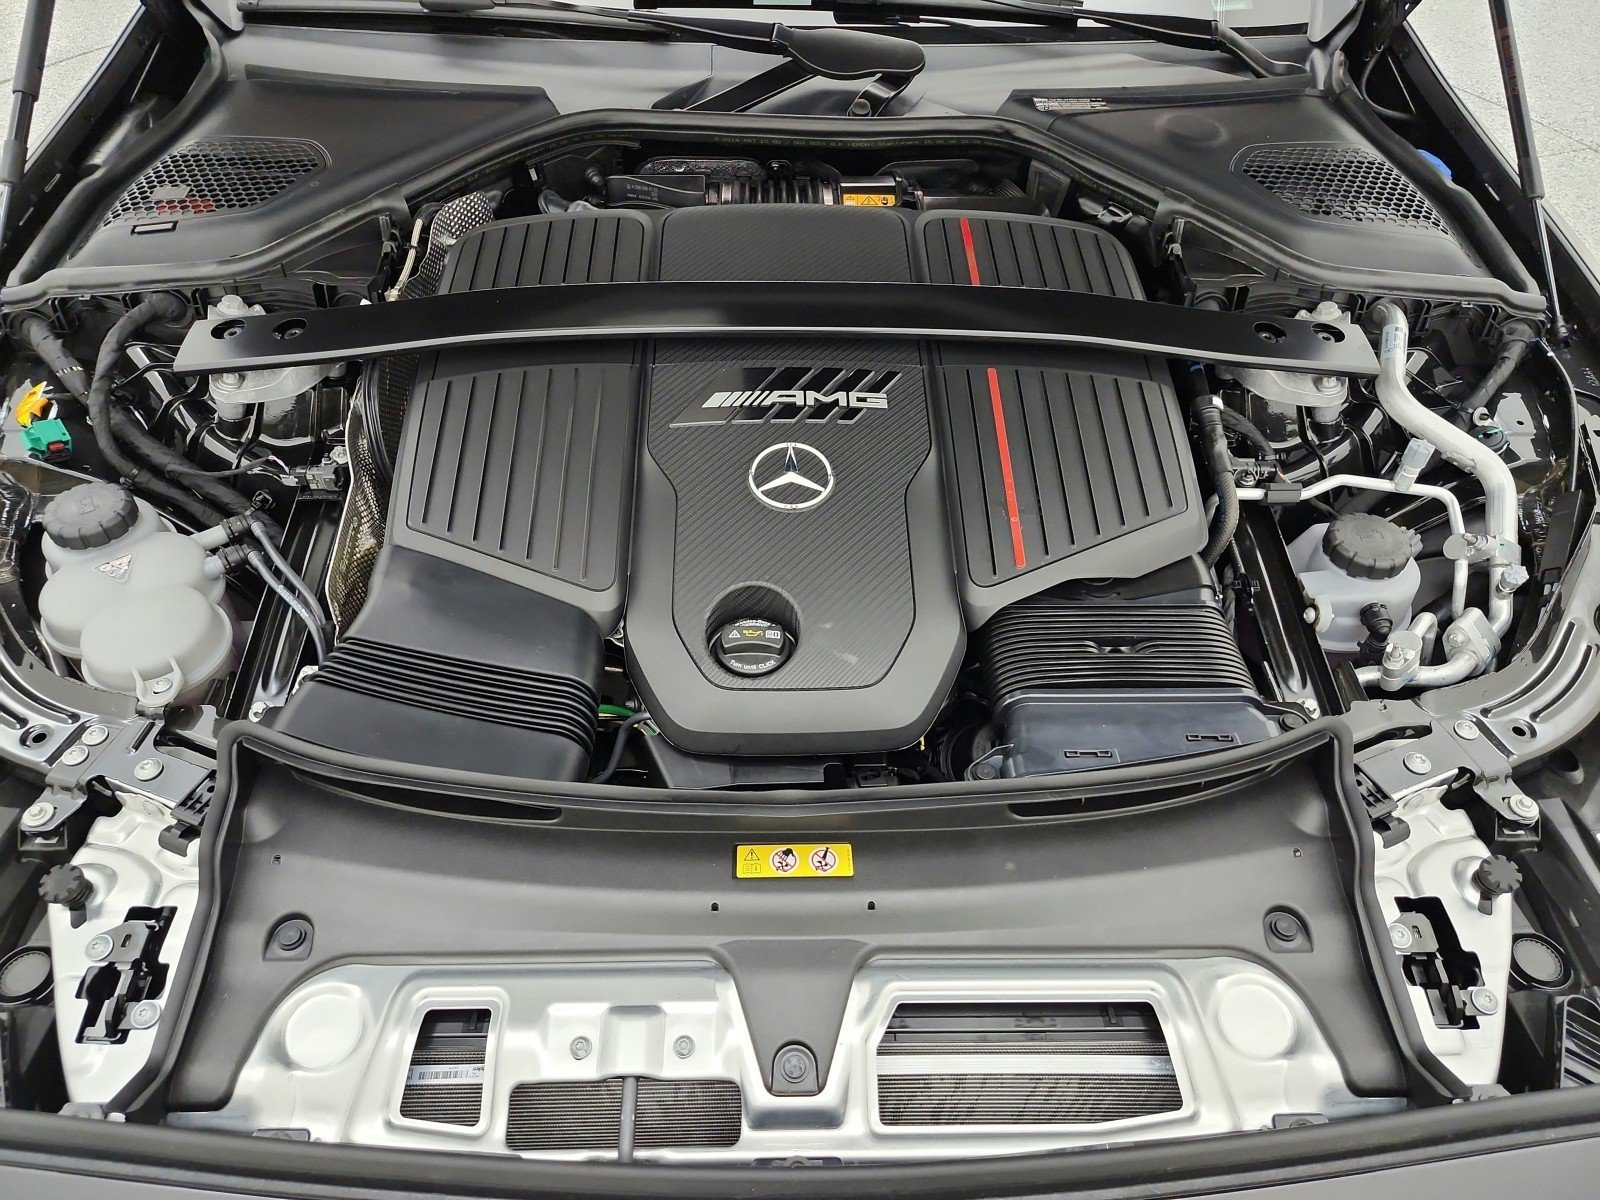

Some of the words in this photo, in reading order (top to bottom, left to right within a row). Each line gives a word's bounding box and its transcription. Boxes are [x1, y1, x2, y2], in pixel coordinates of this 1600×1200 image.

[760, 390, 888, 409] AMG
[730, 660, 742, 668] Turn
[758, 660, 776, 668] CLICK
